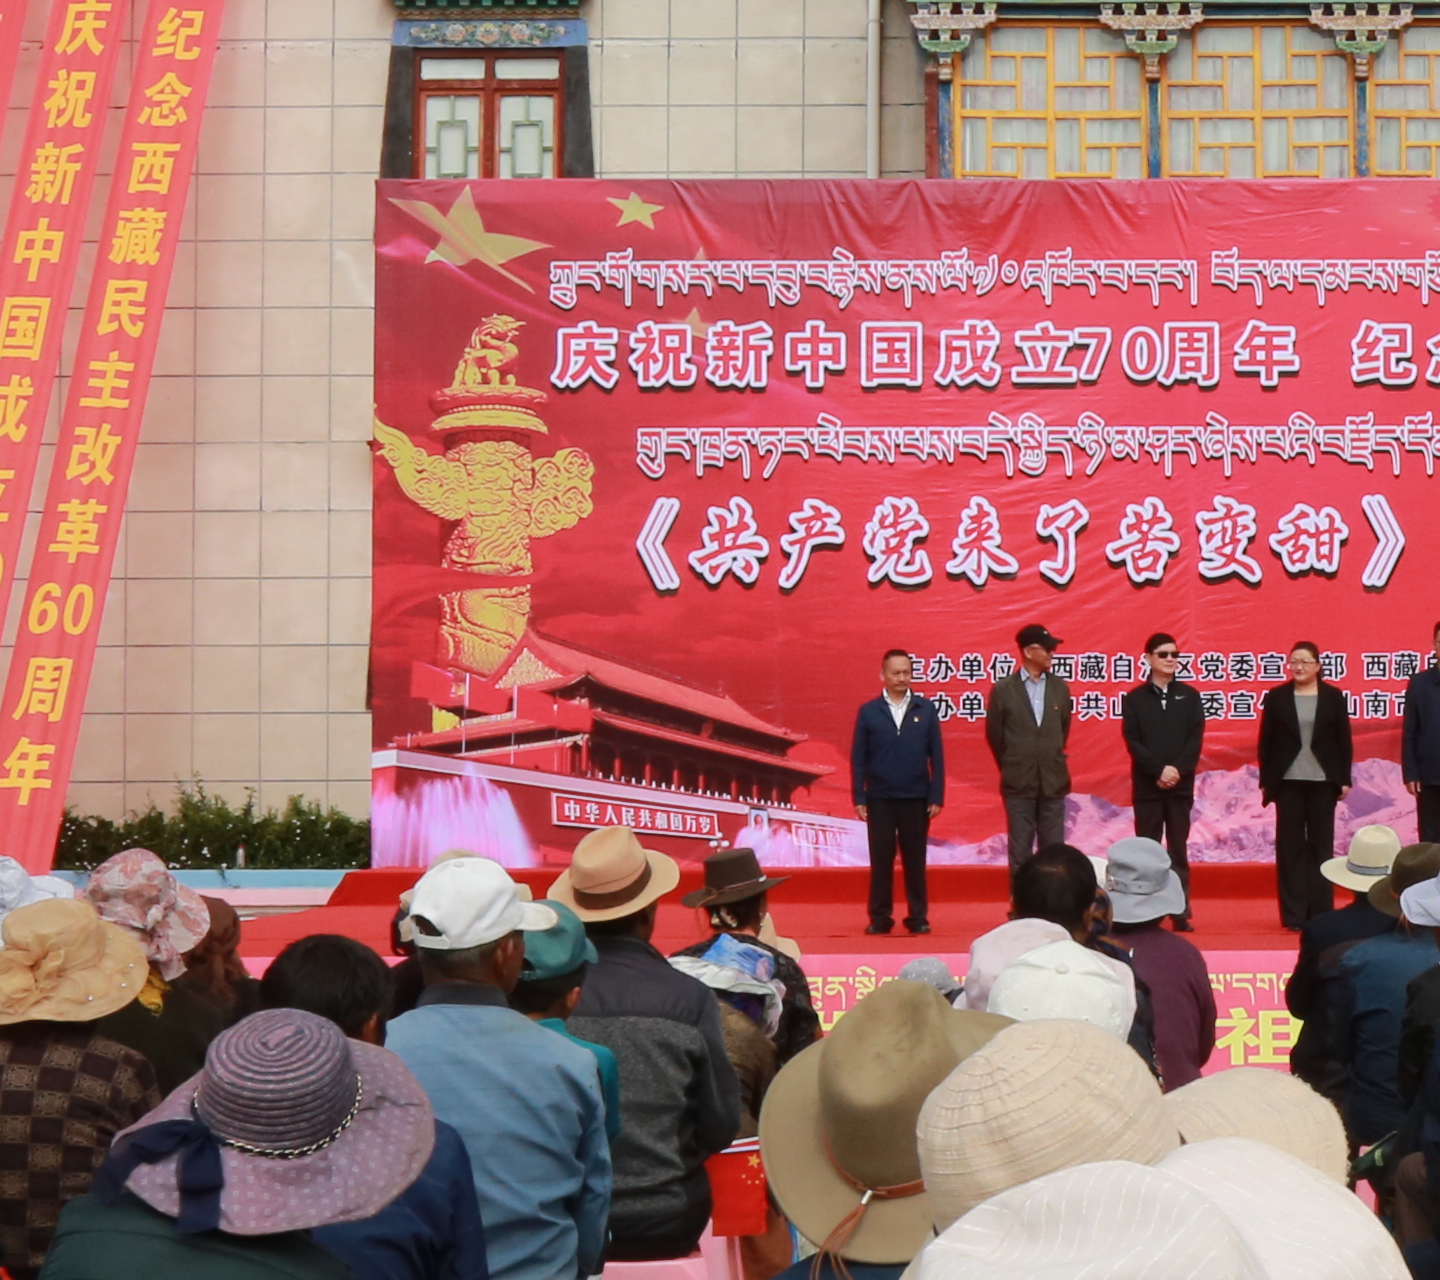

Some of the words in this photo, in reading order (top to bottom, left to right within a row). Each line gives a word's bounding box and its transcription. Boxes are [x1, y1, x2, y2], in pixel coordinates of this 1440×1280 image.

[549, 319, 1300, 388] 庆祝新中国成立70周年
[1051, 652, 1347, 682] 西藏自区党委宣部
[563, 799, 711, 834] 中华人民共和国万岁
[1214, 1006, 1305, 1066] 祖
